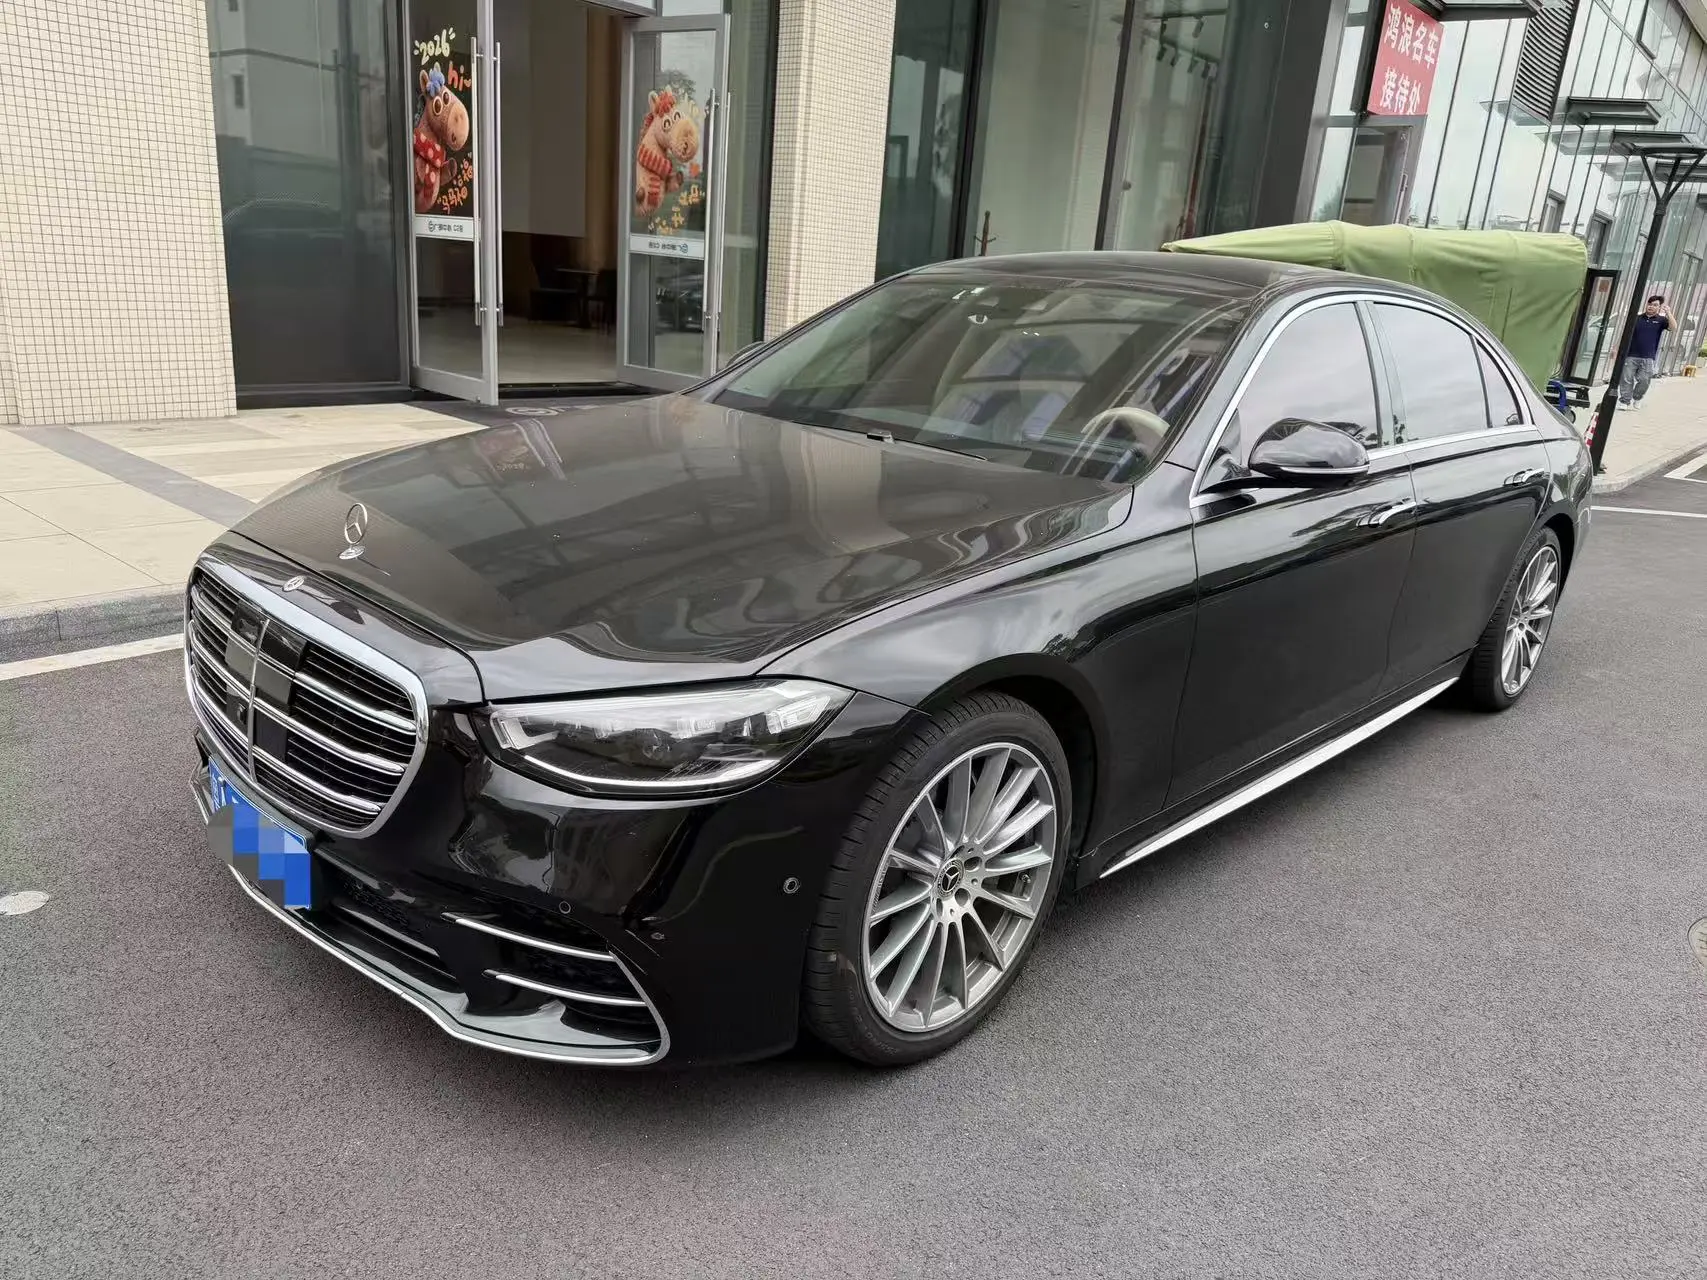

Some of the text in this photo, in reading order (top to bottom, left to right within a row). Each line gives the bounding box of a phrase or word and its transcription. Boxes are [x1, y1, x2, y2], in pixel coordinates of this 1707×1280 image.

[419, 29, 450, 65] 2026
[448, 60, 464, 91] hi
[1380, 67, 1422, 115] 接待处
